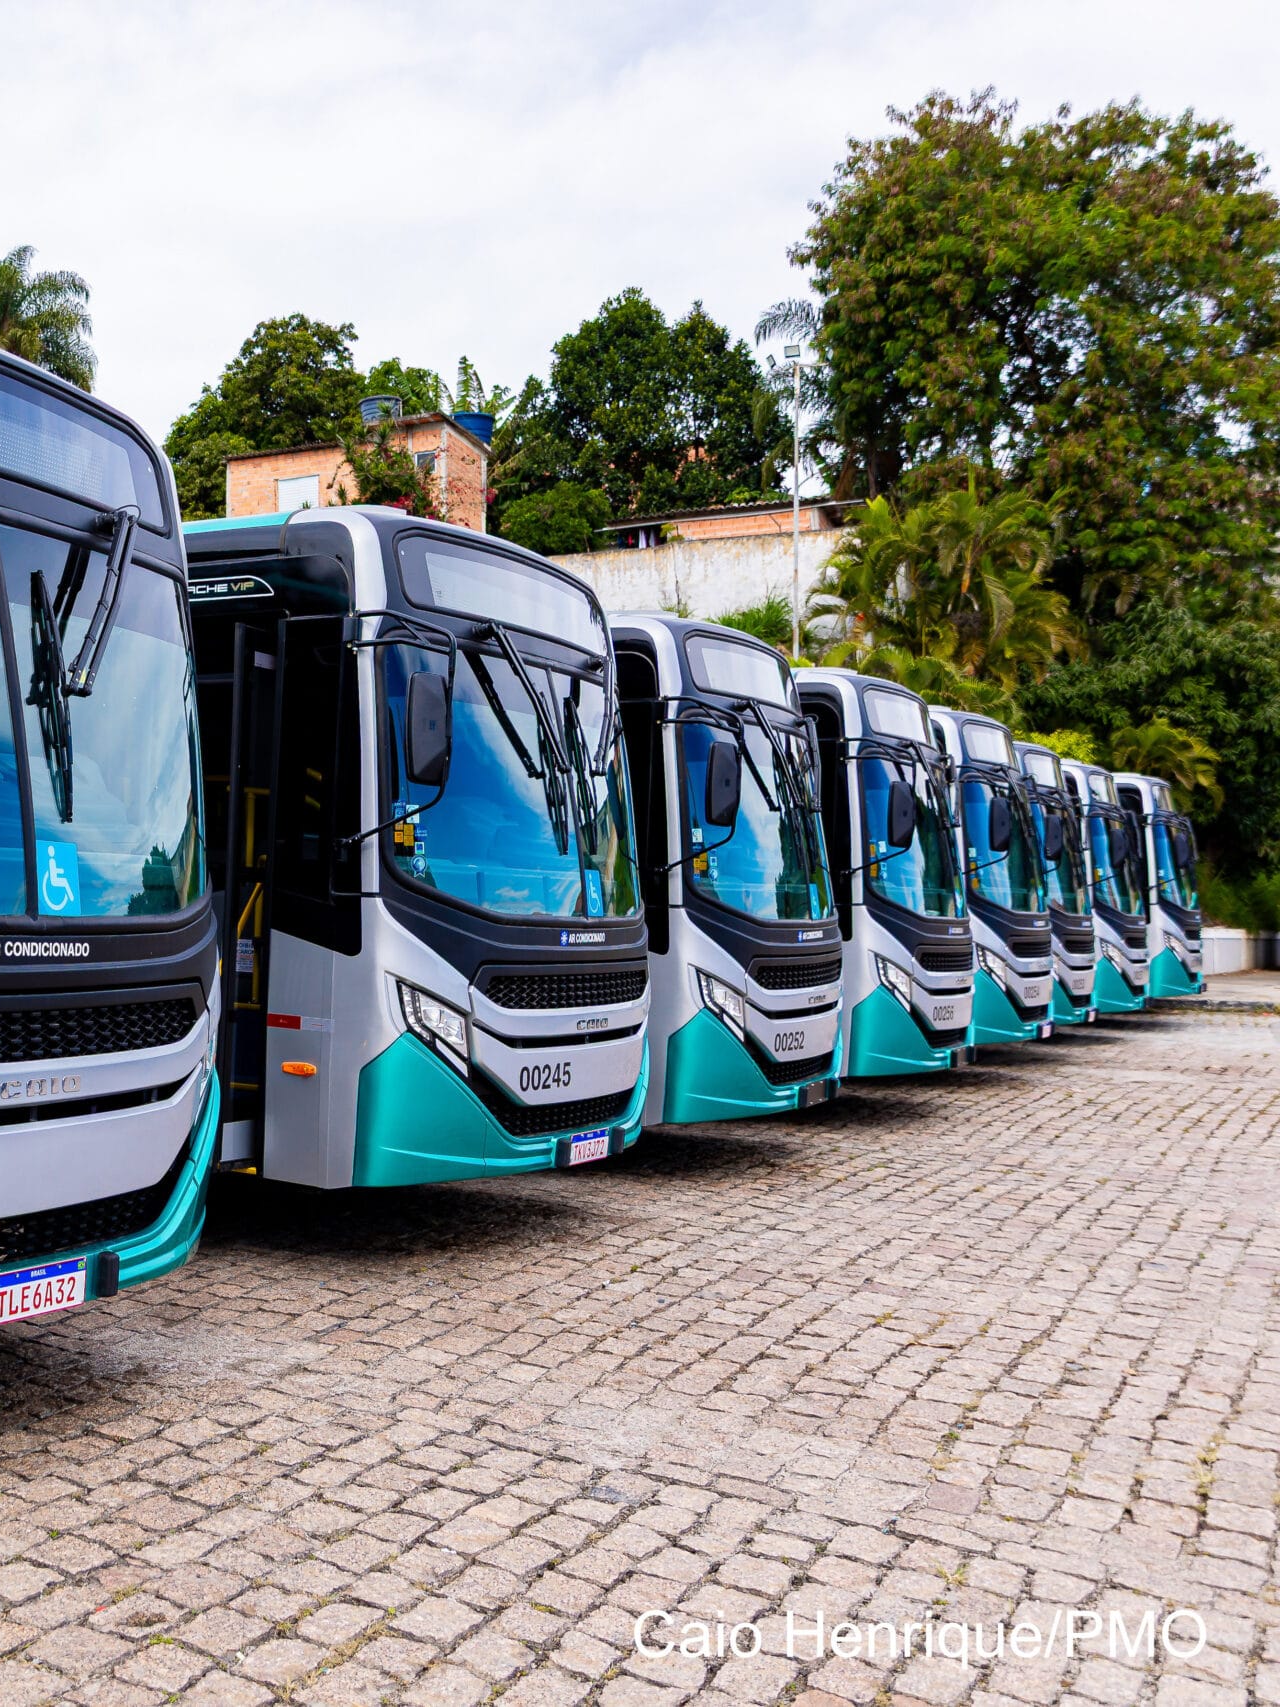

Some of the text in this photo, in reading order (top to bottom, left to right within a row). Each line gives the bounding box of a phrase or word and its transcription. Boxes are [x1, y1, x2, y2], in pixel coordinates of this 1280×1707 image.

[187, 581, 256, 595] ACHE VIP
[568, 931, 606, 944] AR CONDICIONADO
[3, 940, 91, 958] CONDICIONADO
[577, 1017, 609, 1031] CAIO
[774, 1030, 805, 1053] 00252
[519, 1061, 572, 1092] 00245
[0, 1074, 82, 1100] CAIO
[30, 1267, 47, 1279] BRASIL
